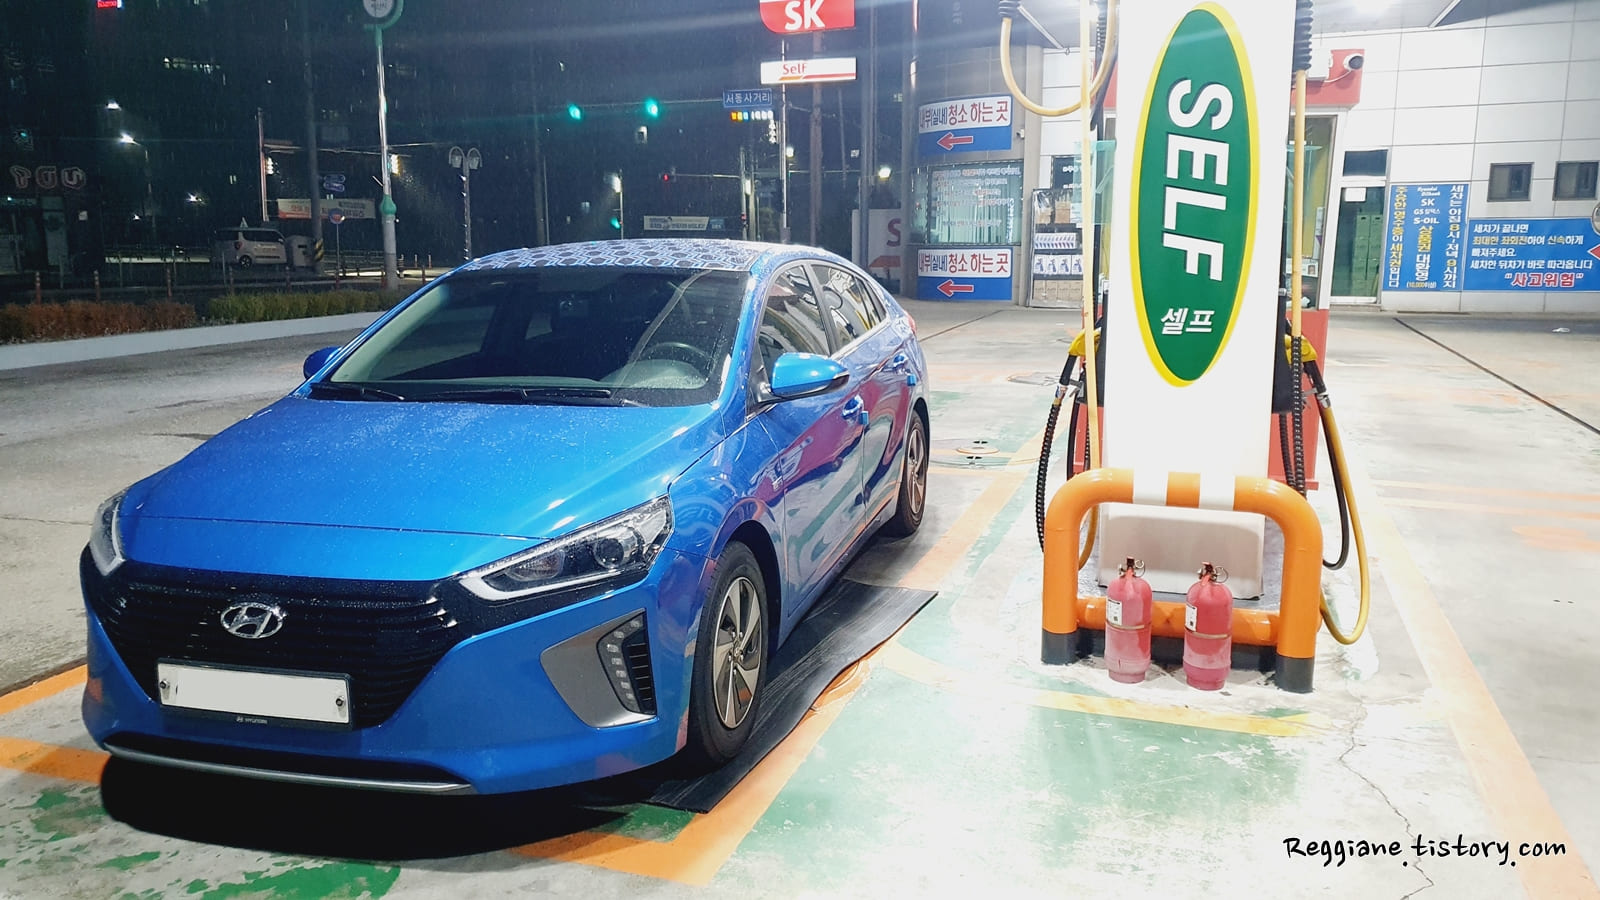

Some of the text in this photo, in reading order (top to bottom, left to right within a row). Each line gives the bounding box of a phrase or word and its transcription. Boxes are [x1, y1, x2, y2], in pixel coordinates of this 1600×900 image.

[785, 0, 825, 31] SK
[726, 92, 770, 104] 서동사거리
[970, 102, 993, 123] 하는
[996, 101, 1009, 122] 곳
[1162, 79, 1233, 281] SELF
[1420, 198, 1435, 207] SK
[1413, 217, 1440, 225] S-OIL
[1473, 224, 1529, 233] 세차가 끝나면
[1547, 235, 1584, 245] 신속하게
[970, 253, 993, 273] 하는
[996, 253, 1009, 273] 곳
[1527, 260, 1545, 269] 바로
[1547, 260, 1593, 269] 따라옵니다
[1160, 307, 1215, 335] 셀프
